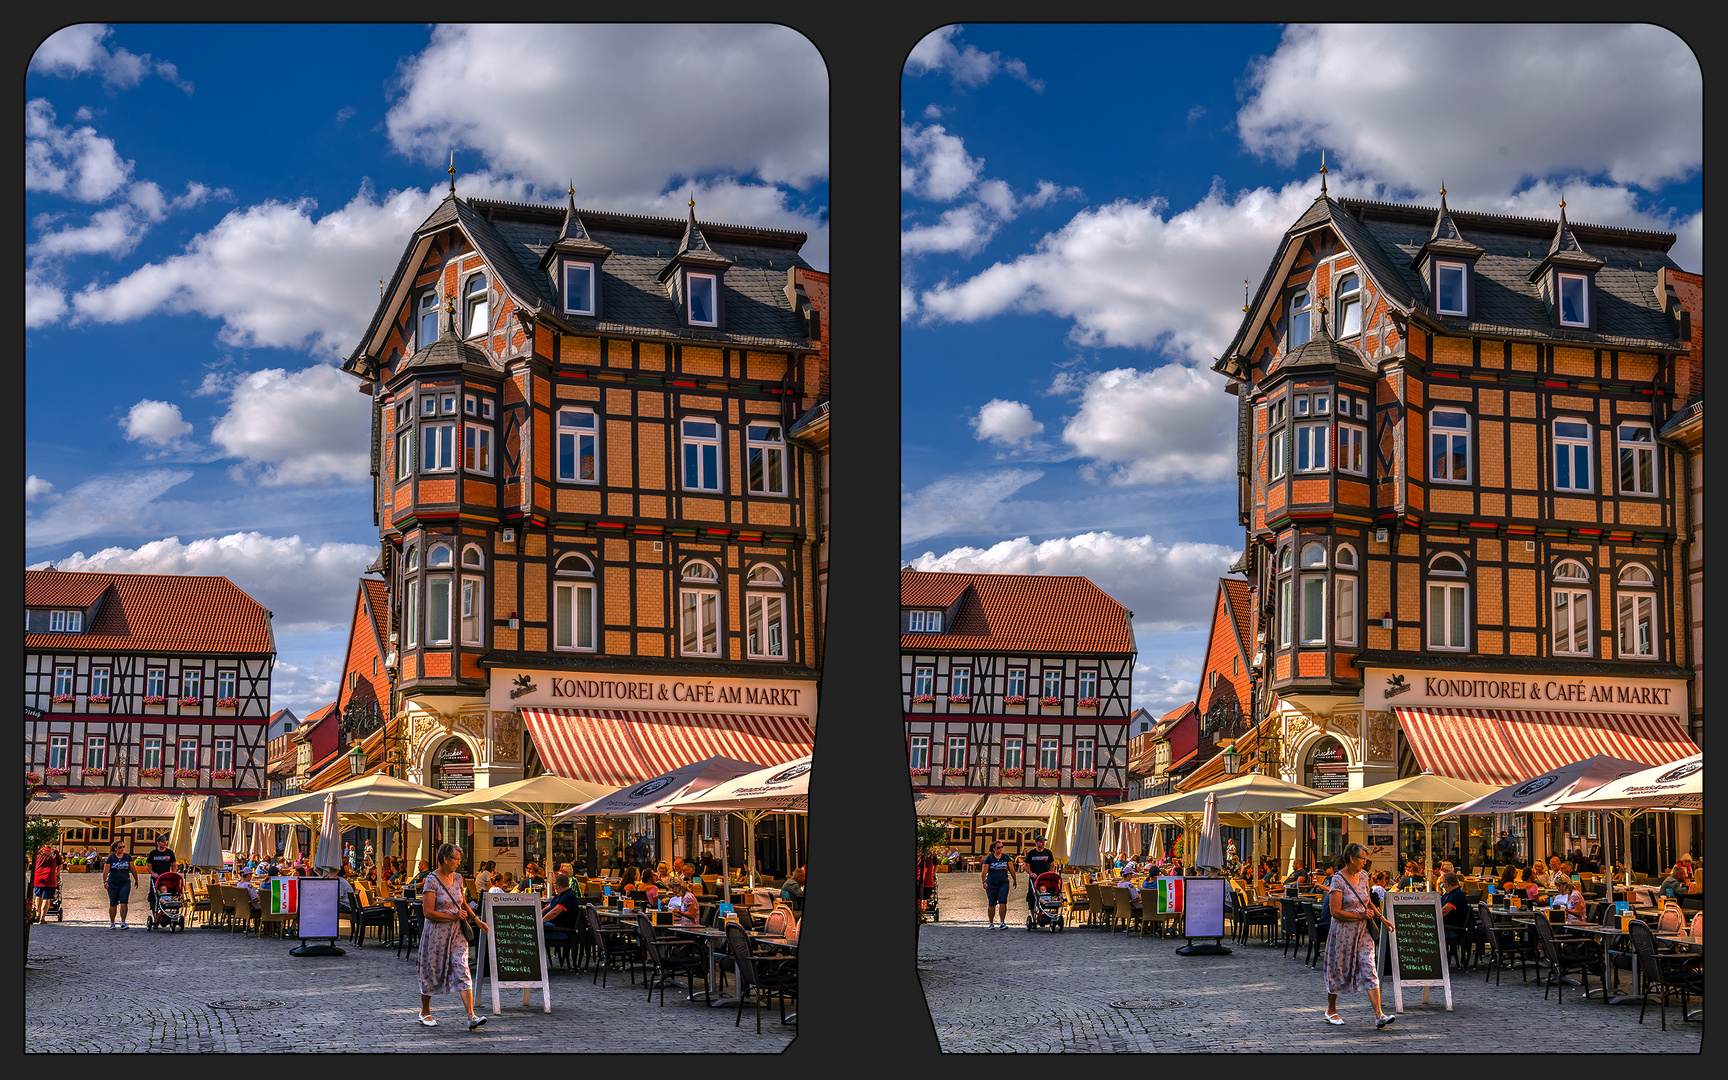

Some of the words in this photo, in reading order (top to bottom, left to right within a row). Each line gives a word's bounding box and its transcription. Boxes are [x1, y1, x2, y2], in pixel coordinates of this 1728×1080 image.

[552, 678, 653, 700] KONDITOREI
[658, 683, 669, 701] &
[673, 681, 715, 703] CAFÉ
[718, 687, 742, 704] AM
[746, 687, 800, 706] MARKT
[1425, 677, 1526, 699] KONDITOREI
[1530, 682, 1541, 700] &
[1545, 680, 1587, 702] CAFÉ
[1590, 686, 1613, 703] AM
[1617, 686, 1671, 705] MARKT
